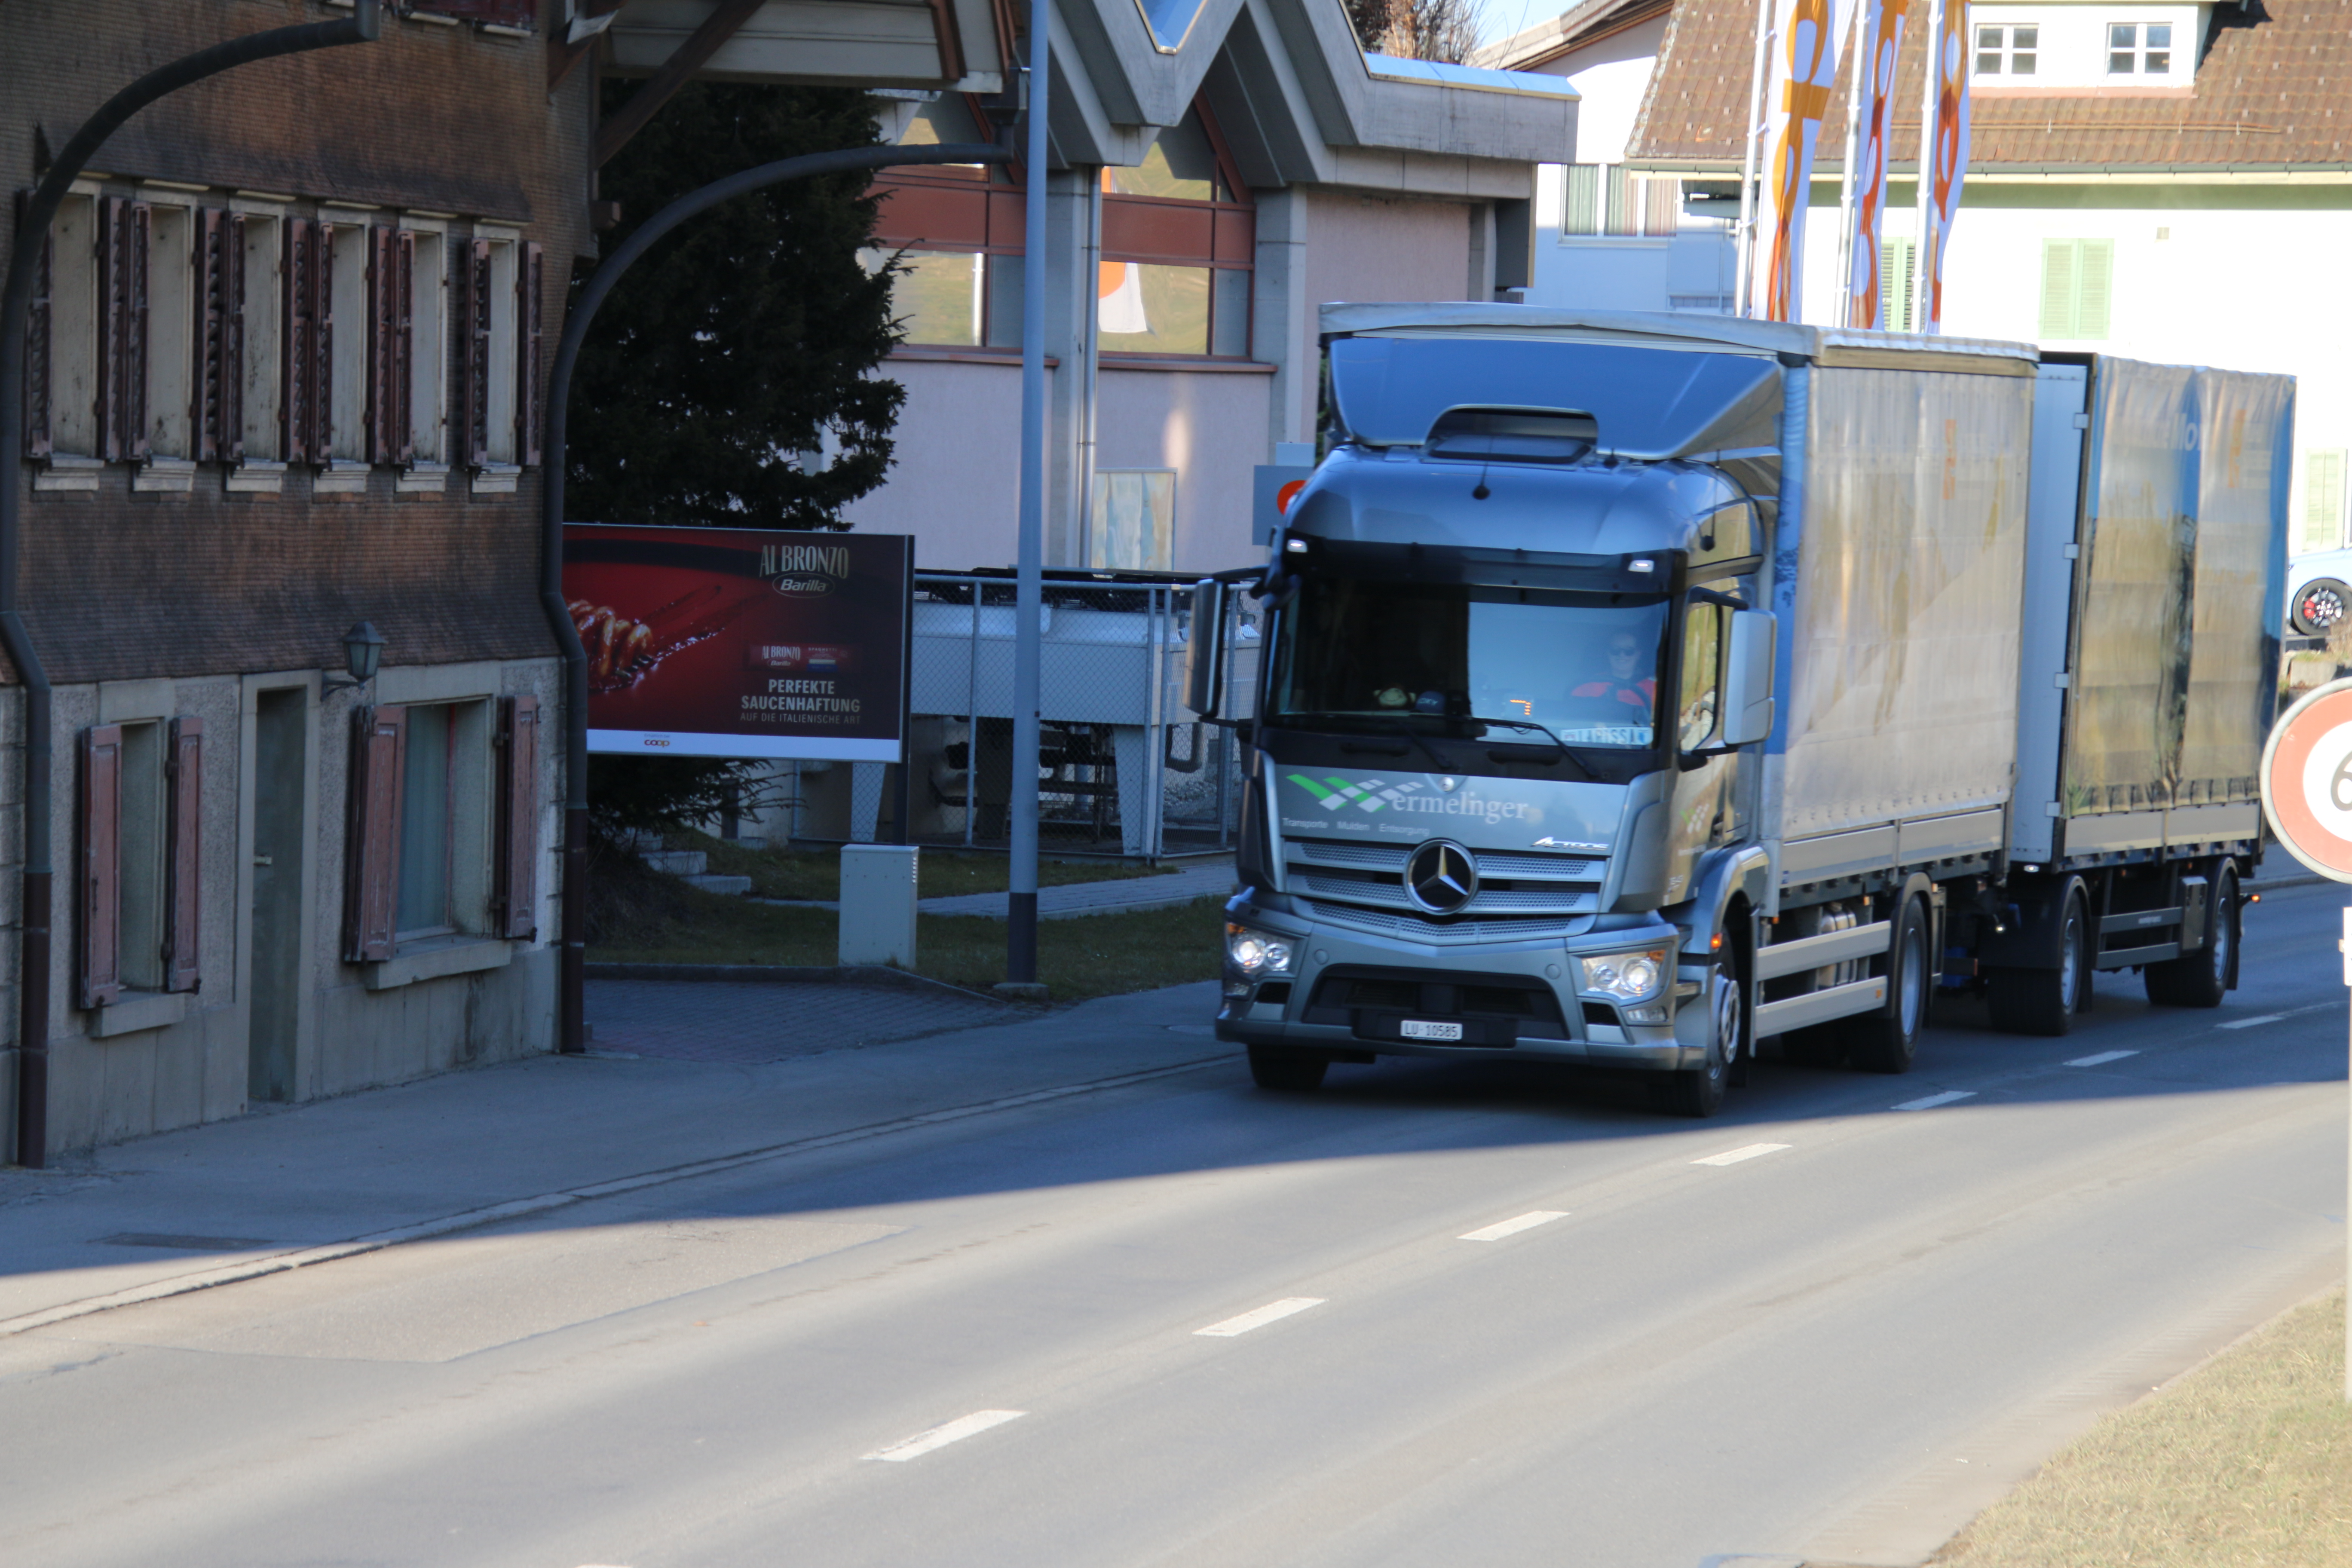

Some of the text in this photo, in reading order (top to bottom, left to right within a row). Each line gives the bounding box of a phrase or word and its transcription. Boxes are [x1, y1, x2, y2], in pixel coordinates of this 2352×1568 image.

[759, 545, 849, 579] AL BRONZO
[780, 579, 827, 591] Barilla
[762, 646, 801, 661] AL BRONZO
[769, 679, 834, 694] PERFEKTE
[741, 695, 860, 712] SAUCENHAFTUNG
[740, 713, 861, 724] AUF DIE ITALIENISCHE ART
[644, 739, 670, 748] coop
[1378, 824, 1430, 836] Entsorgung
